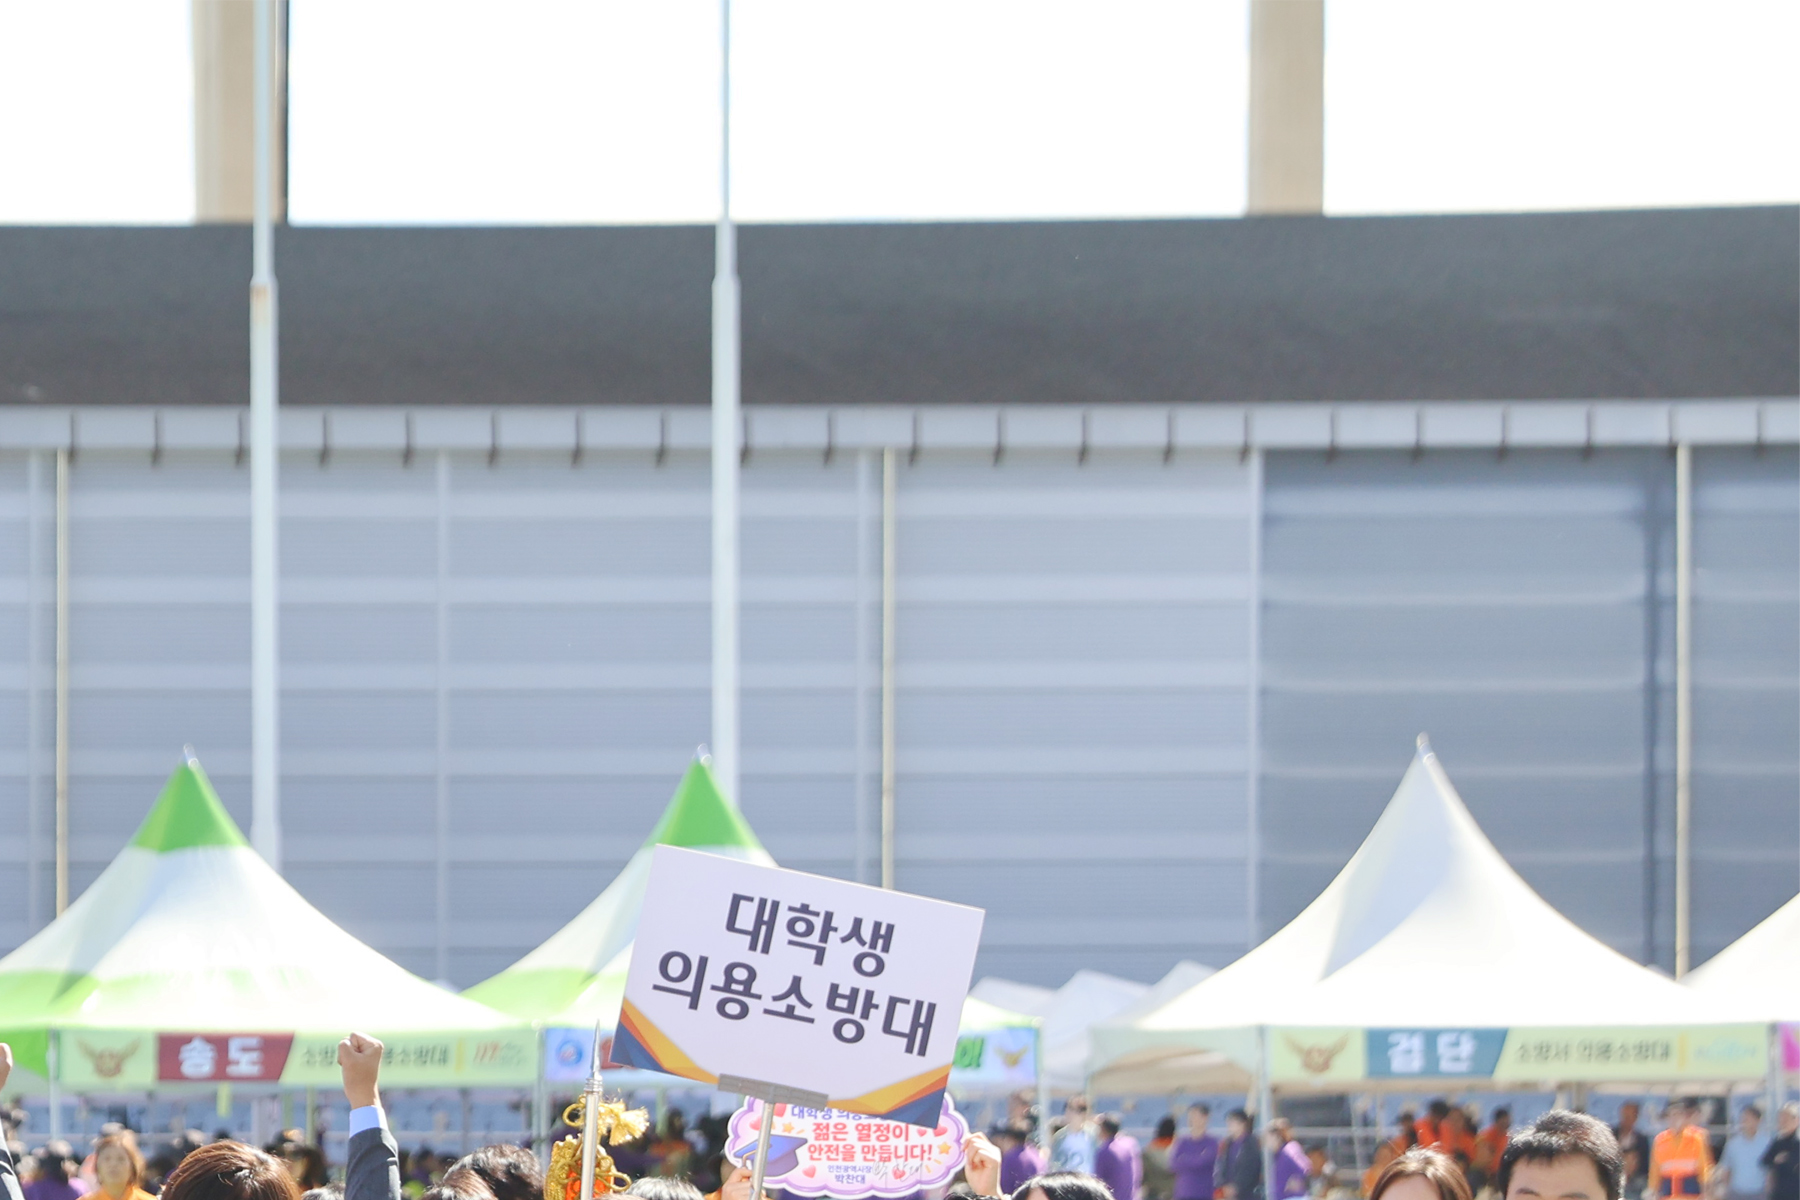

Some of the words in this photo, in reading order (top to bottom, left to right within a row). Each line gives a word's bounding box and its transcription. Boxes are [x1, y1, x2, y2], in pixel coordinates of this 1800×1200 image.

[725, 892, 896, 978] 대학생
[652, 950, 938, 1058] 의용소방대
[811, 1122, 849, 1142] 젊은
[855, 1122, 910, 1142] 열정이
[808, 1144, 856, 1162] 안전을
[861, 1144, 933, 1163] 만듭니다!
[827, 1164, 872, 1174] 인천광역시장
[834, 1174, 866, 1185] 박찬대
